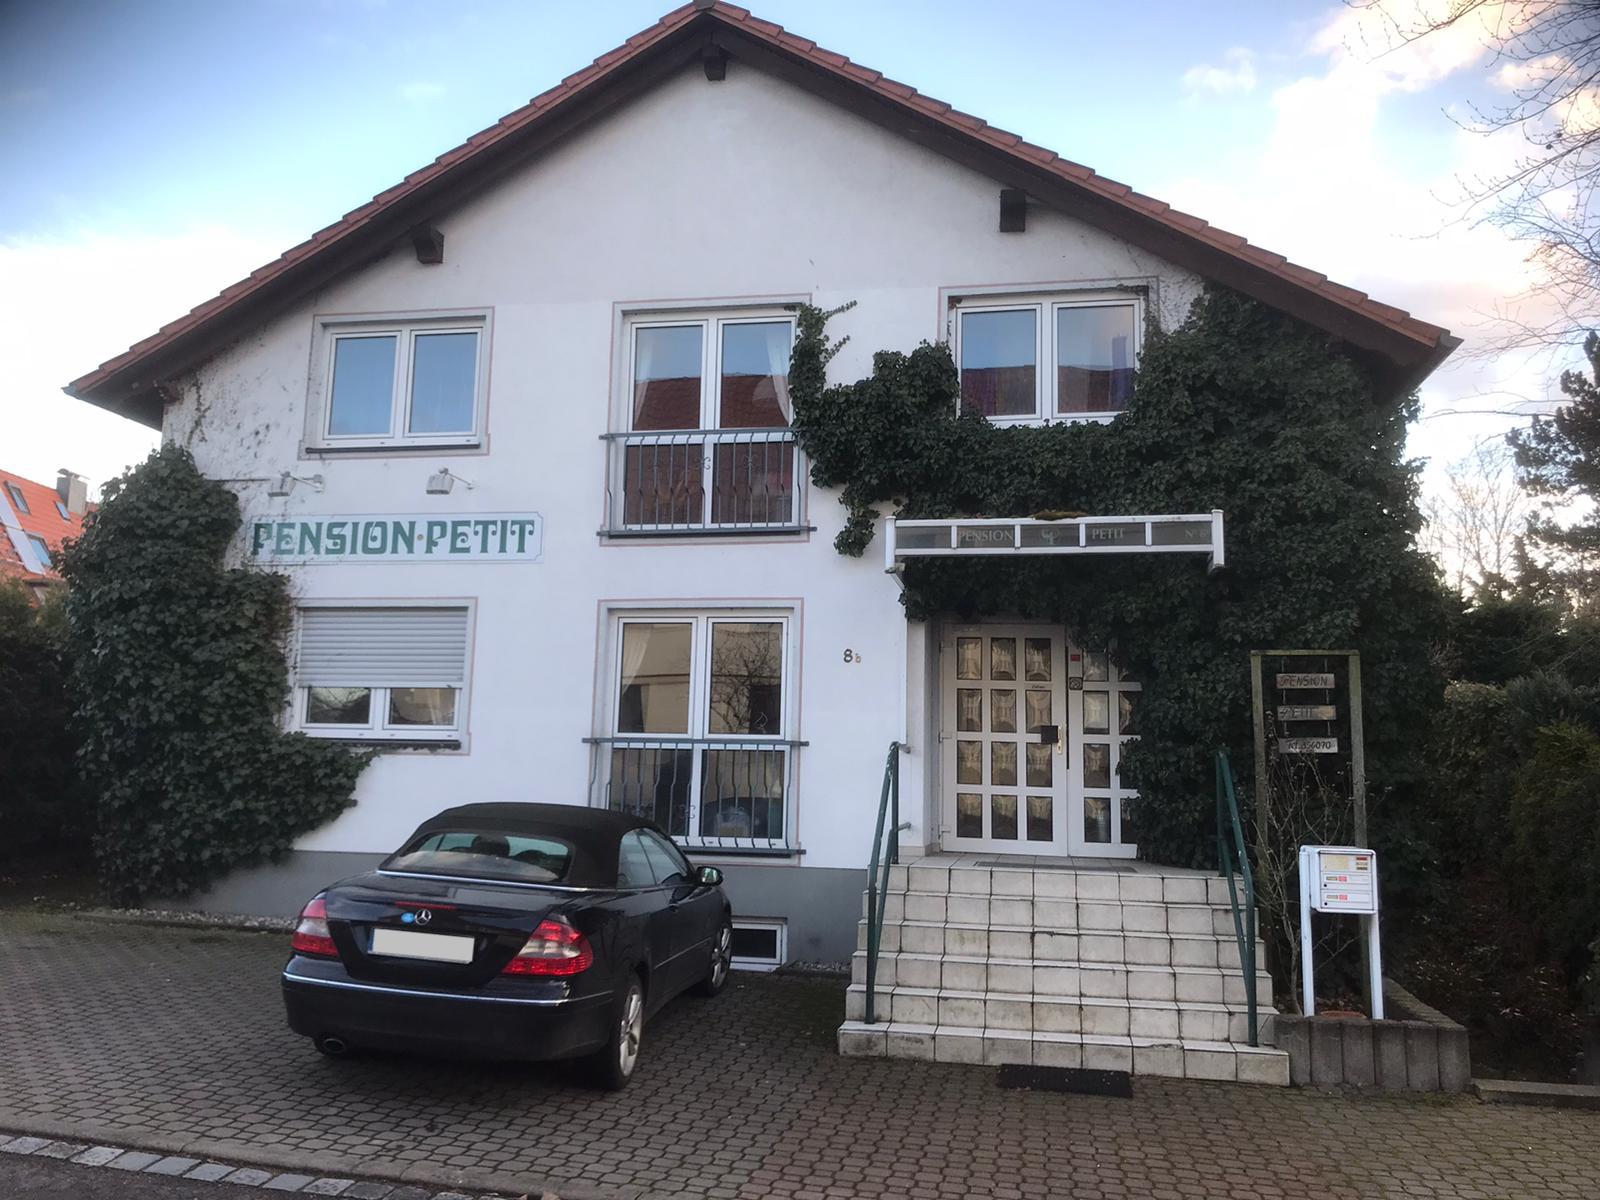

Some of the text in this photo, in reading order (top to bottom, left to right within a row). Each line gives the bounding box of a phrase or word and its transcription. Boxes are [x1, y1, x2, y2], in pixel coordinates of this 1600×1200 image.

[252, 519, 535, 556] PENSION PETIT
[957, 529, 1013, 543] PENSION
[1091, 527, 1126, 540] PETIT
